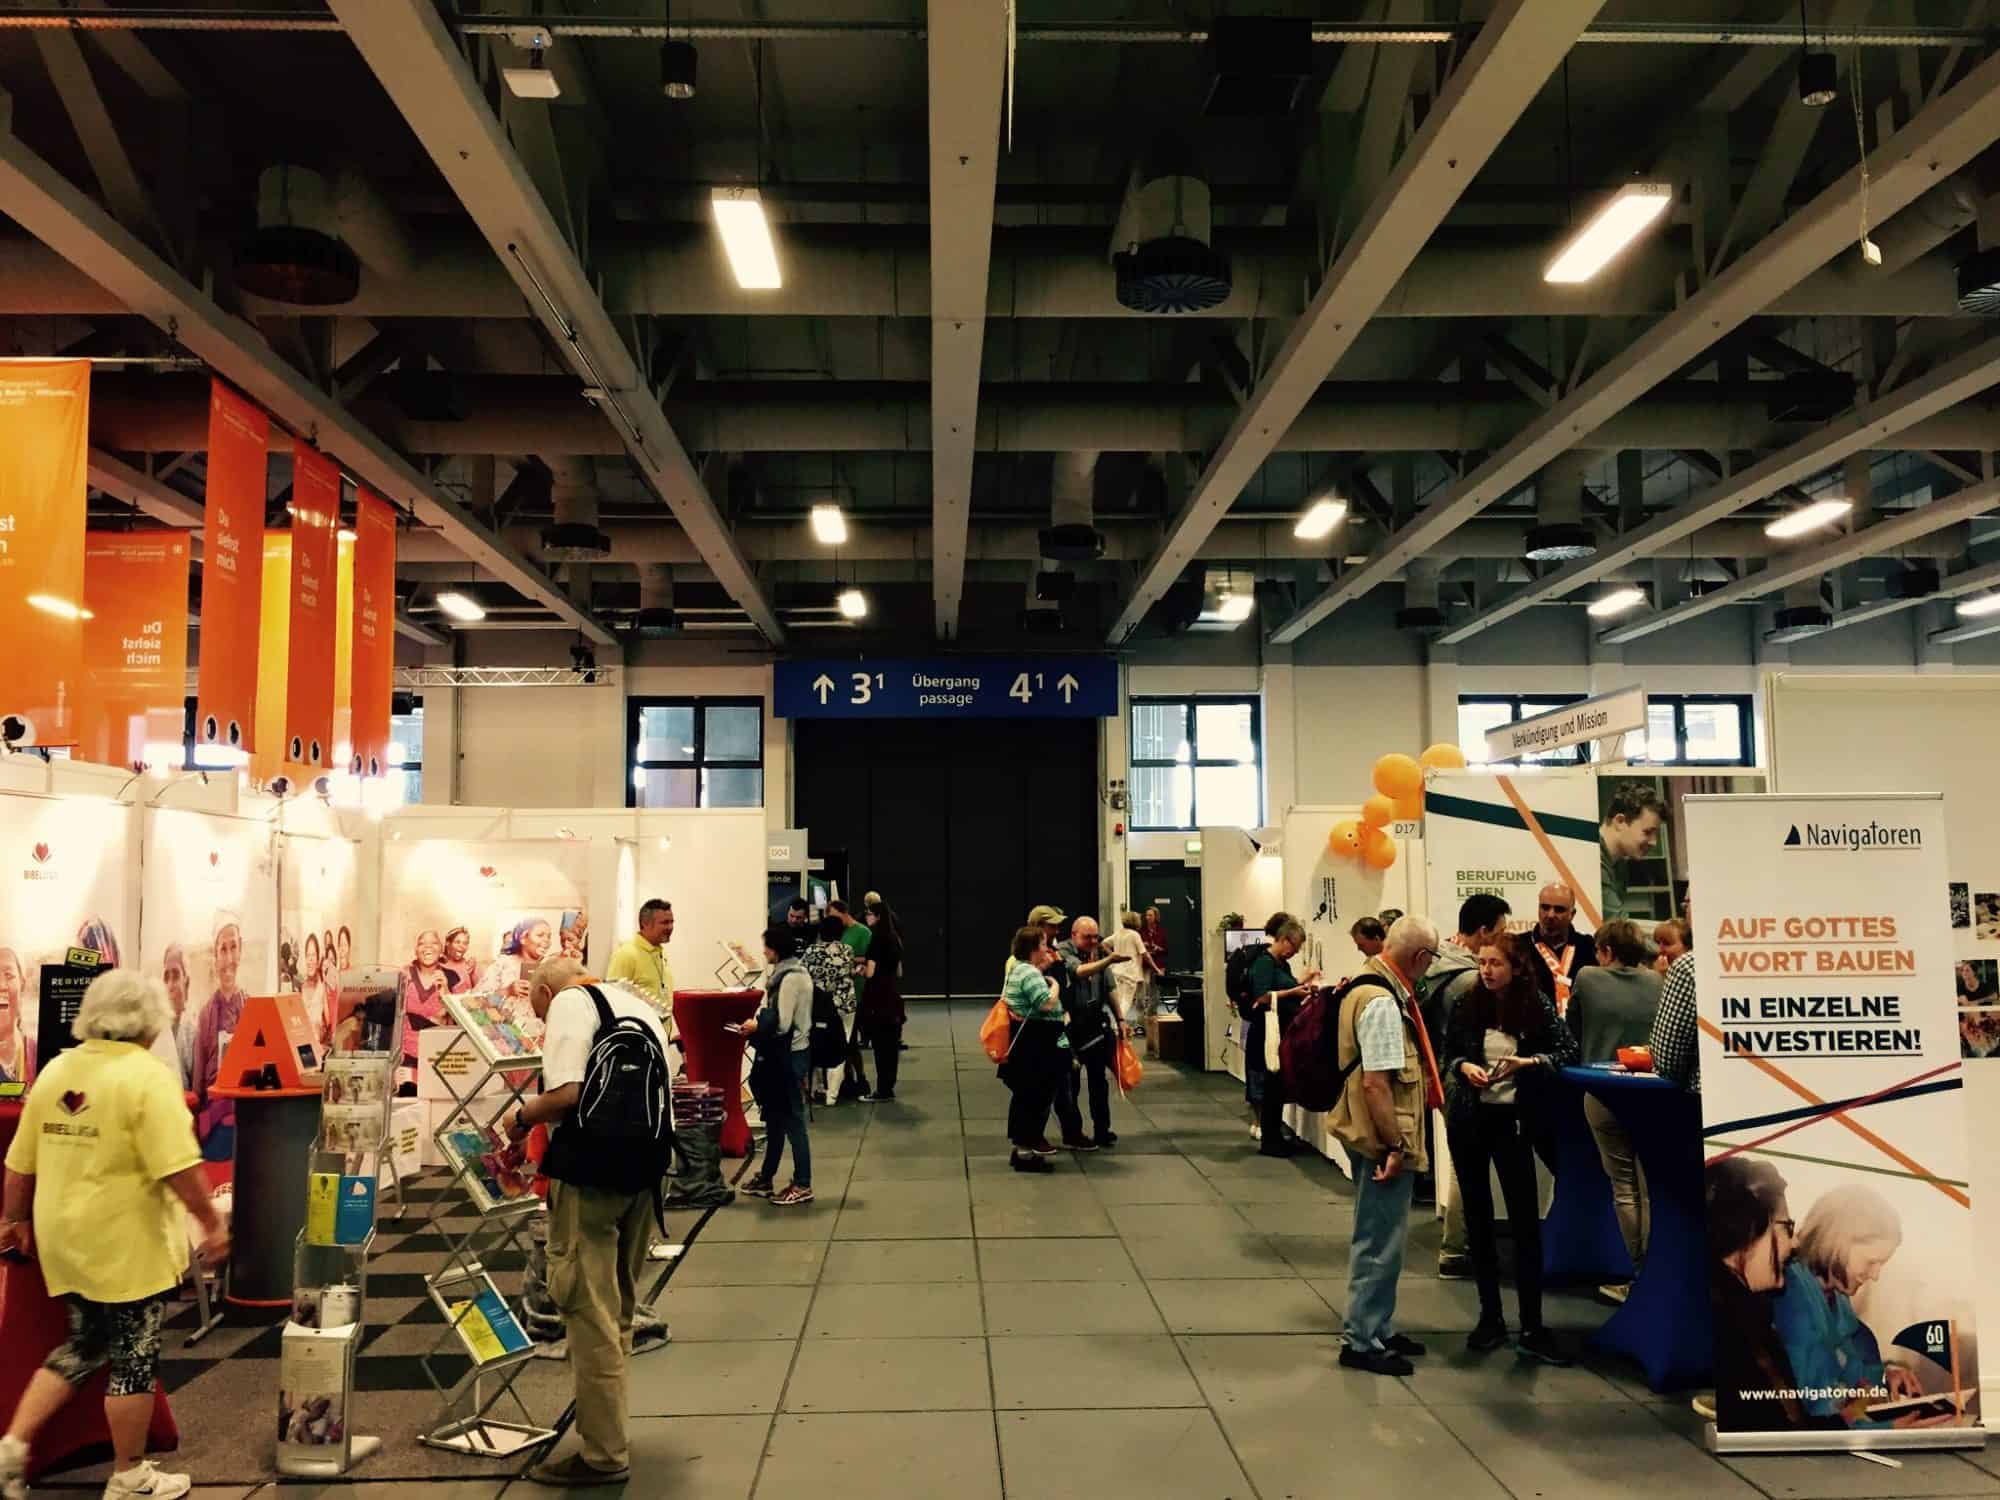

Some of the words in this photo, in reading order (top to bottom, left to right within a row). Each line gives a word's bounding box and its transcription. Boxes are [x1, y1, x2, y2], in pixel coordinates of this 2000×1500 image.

[912, 673, 980, 690] Übergang
[919, 694, 973, 707] passage
[1512, 723, 1559, 749] Verkündigung
[1560, 714, 1575, 737] und
[1576, 709, 1608, 734] Mission
[1395, 823, 1416, 834] D17
[1807, 820, 1922, 851] Navigatoren
[1456, 870, 1537, 881] BERUFUNG
[1457, 887, 1505, 898] LEBEN
[1717, 918, 1777, 938] AUF
[1783, 917, 1896, 938] GOTTES
[1719, 951, 1808, 972] WORT
[1815, 950, 1915, 971] BAUEN
[1721, 997, 1751, 1018] IN
[1760, 996, 1900, 1017] EINZELNE
[1722, 1030, 1922, 1052] INVESTIEREN!
[1926, 1325, 1944, 1345] 60
[1739, 1385, 1888, 1401] www.navigatoren.de
